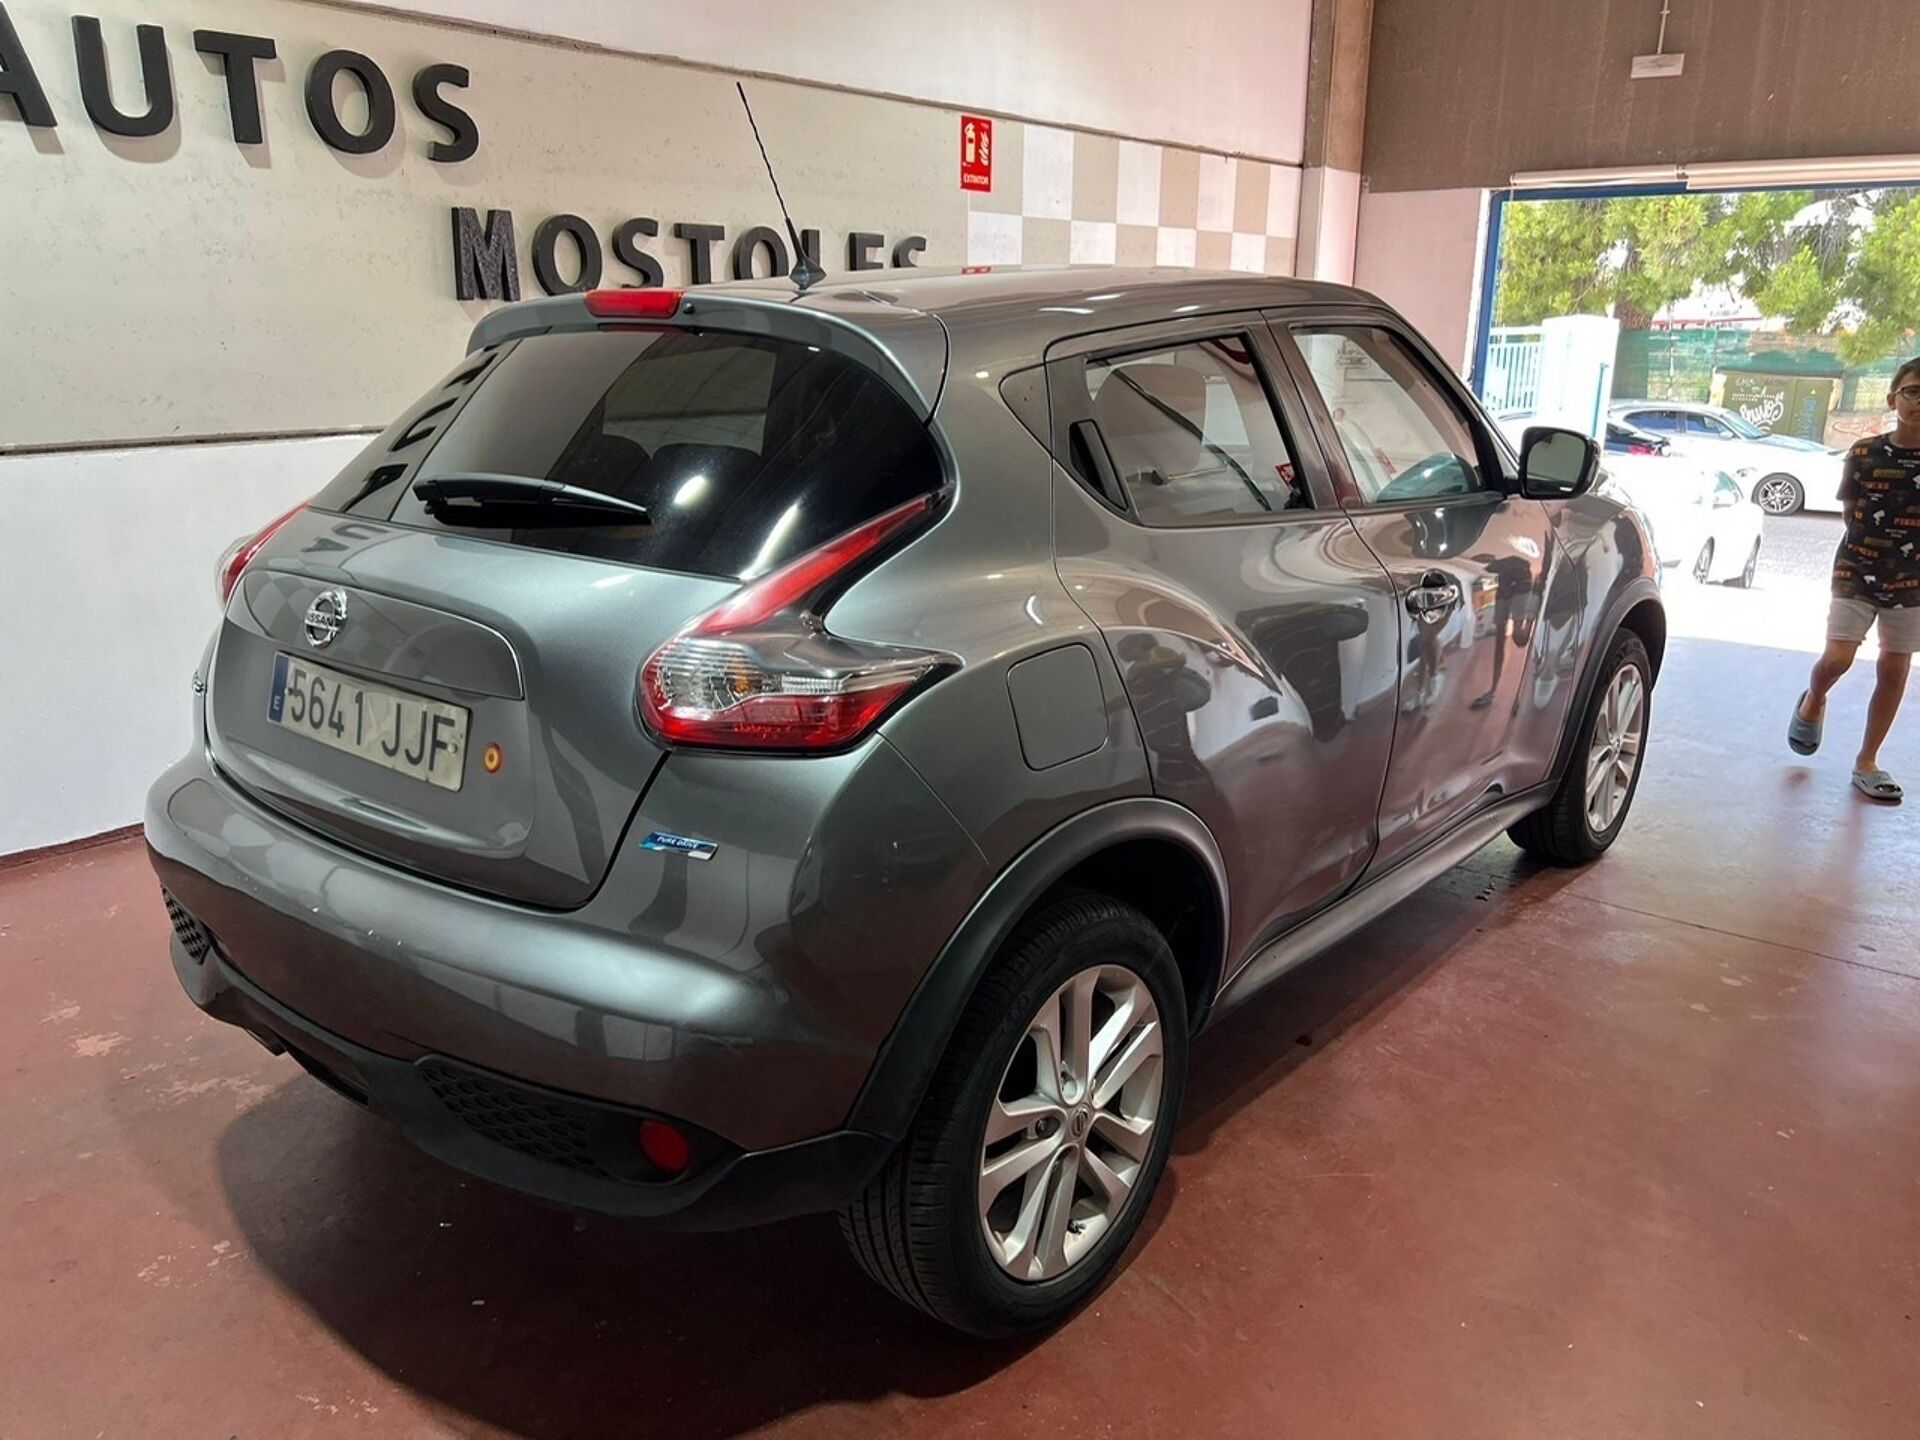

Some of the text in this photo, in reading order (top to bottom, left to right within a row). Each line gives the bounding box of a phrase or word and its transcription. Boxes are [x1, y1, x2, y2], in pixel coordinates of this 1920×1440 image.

[0, 1, 480, 163] AUTOS
[273, 695, 282, 711] E
[289, 668, 456, 772] 5641 JJF
